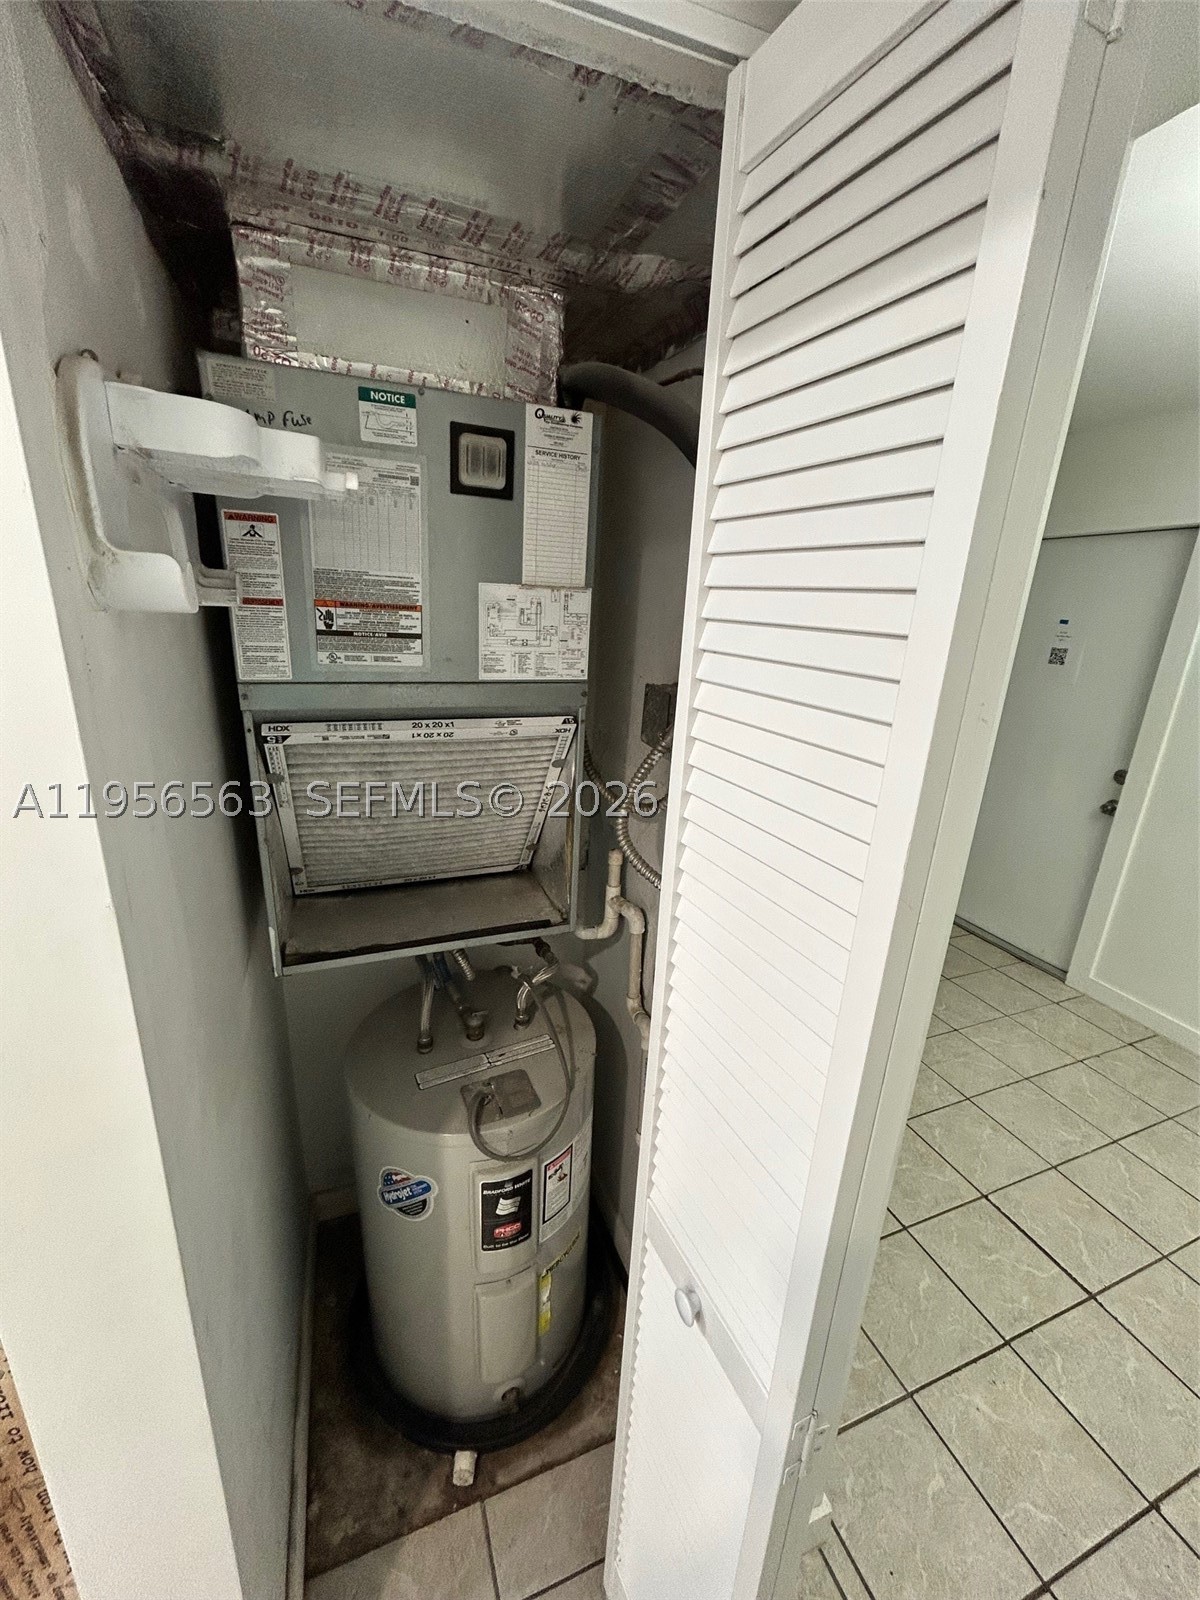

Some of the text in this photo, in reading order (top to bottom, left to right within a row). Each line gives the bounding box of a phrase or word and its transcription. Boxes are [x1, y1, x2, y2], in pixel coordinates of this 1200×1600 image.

[370, 390, 406, 404] NOTICE
[535, 449, 581, 461] SERVICE HISTORY
[235, 512, 273, 523] WARNING
[383, 1186, 413, 1204] Hydrojet
[482, 1177, 532, 1195] BRADFORD WHITE
[8, 1426, 24, 1445] to
[17, 1449, 38, 1477] how
